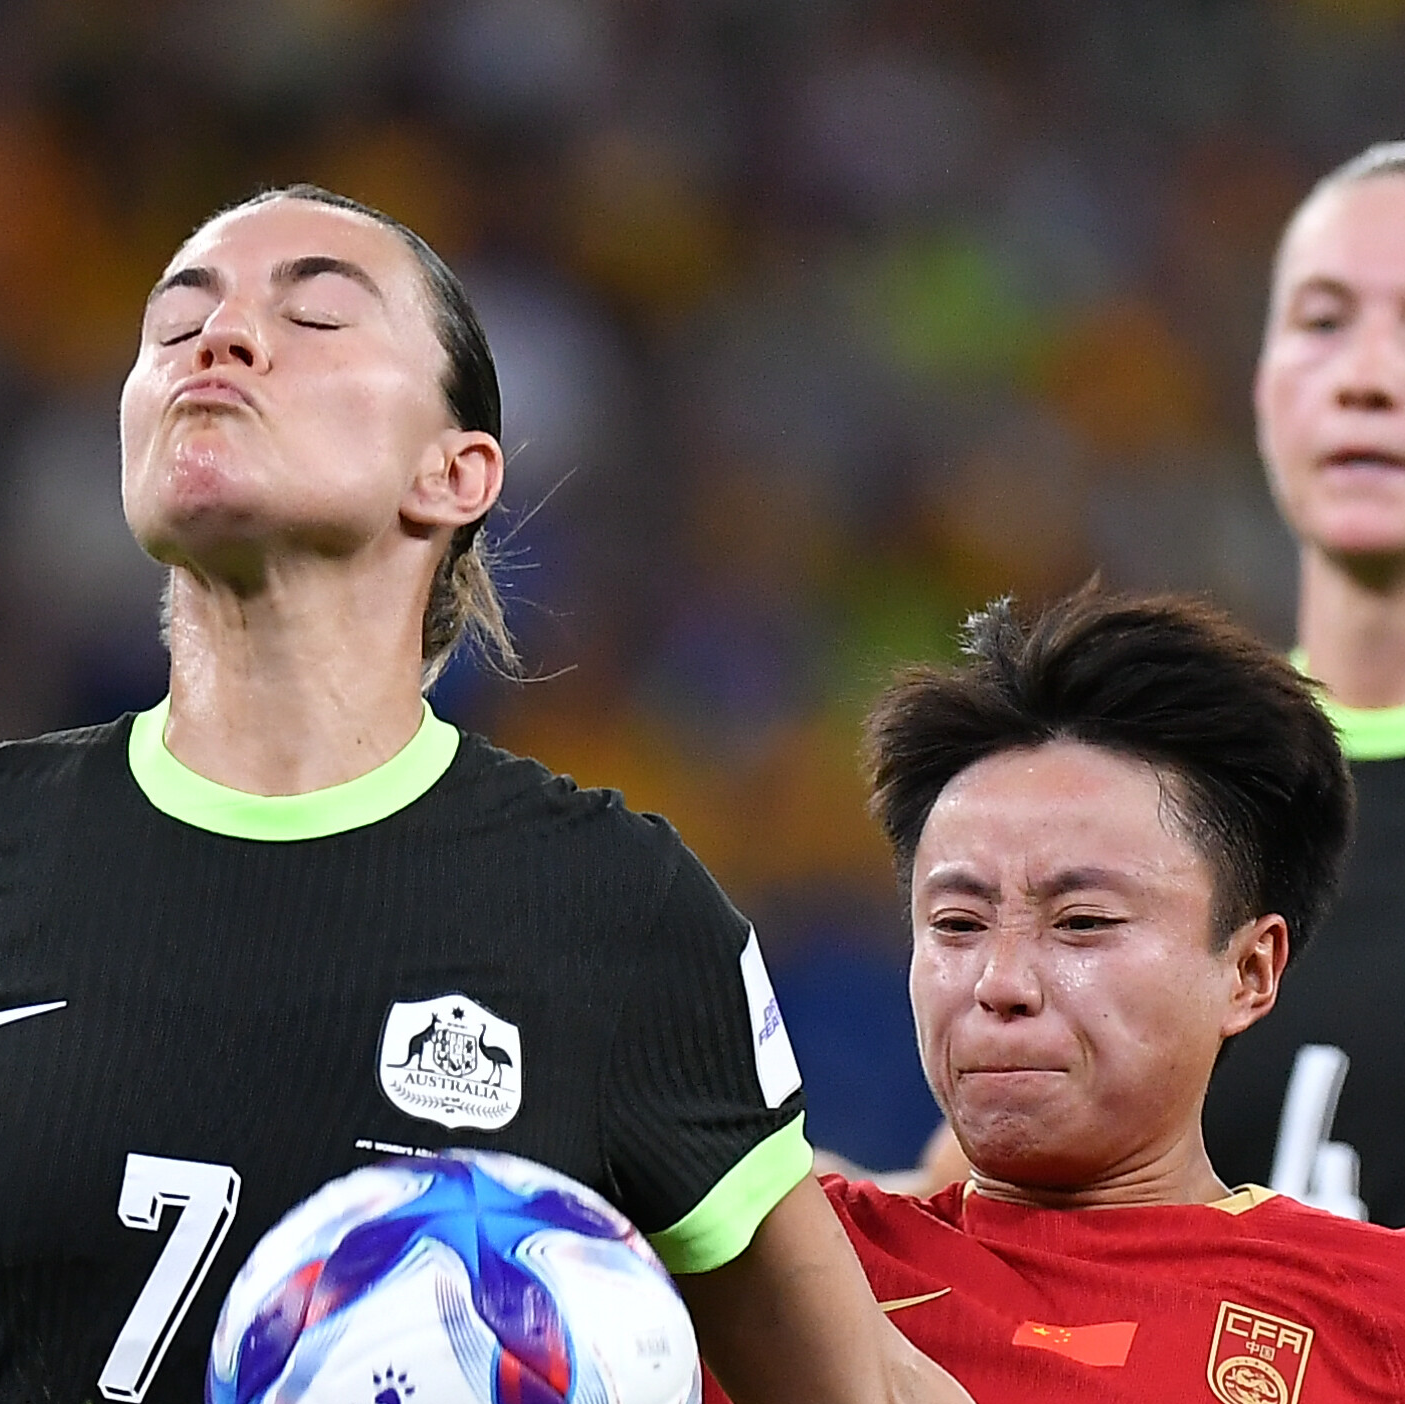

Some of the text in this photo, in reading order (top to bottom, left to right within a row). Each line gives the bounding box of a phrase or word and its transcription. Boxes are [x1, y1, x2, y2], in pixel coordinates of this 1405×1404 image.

[404, 1073, 499, 1101] AUSTRALIA
[97, 1152, 242, 1404] 7
[1226, 1312, 1303, 1354] CFA
[1245, 1341, 1276, 1361] 中国
